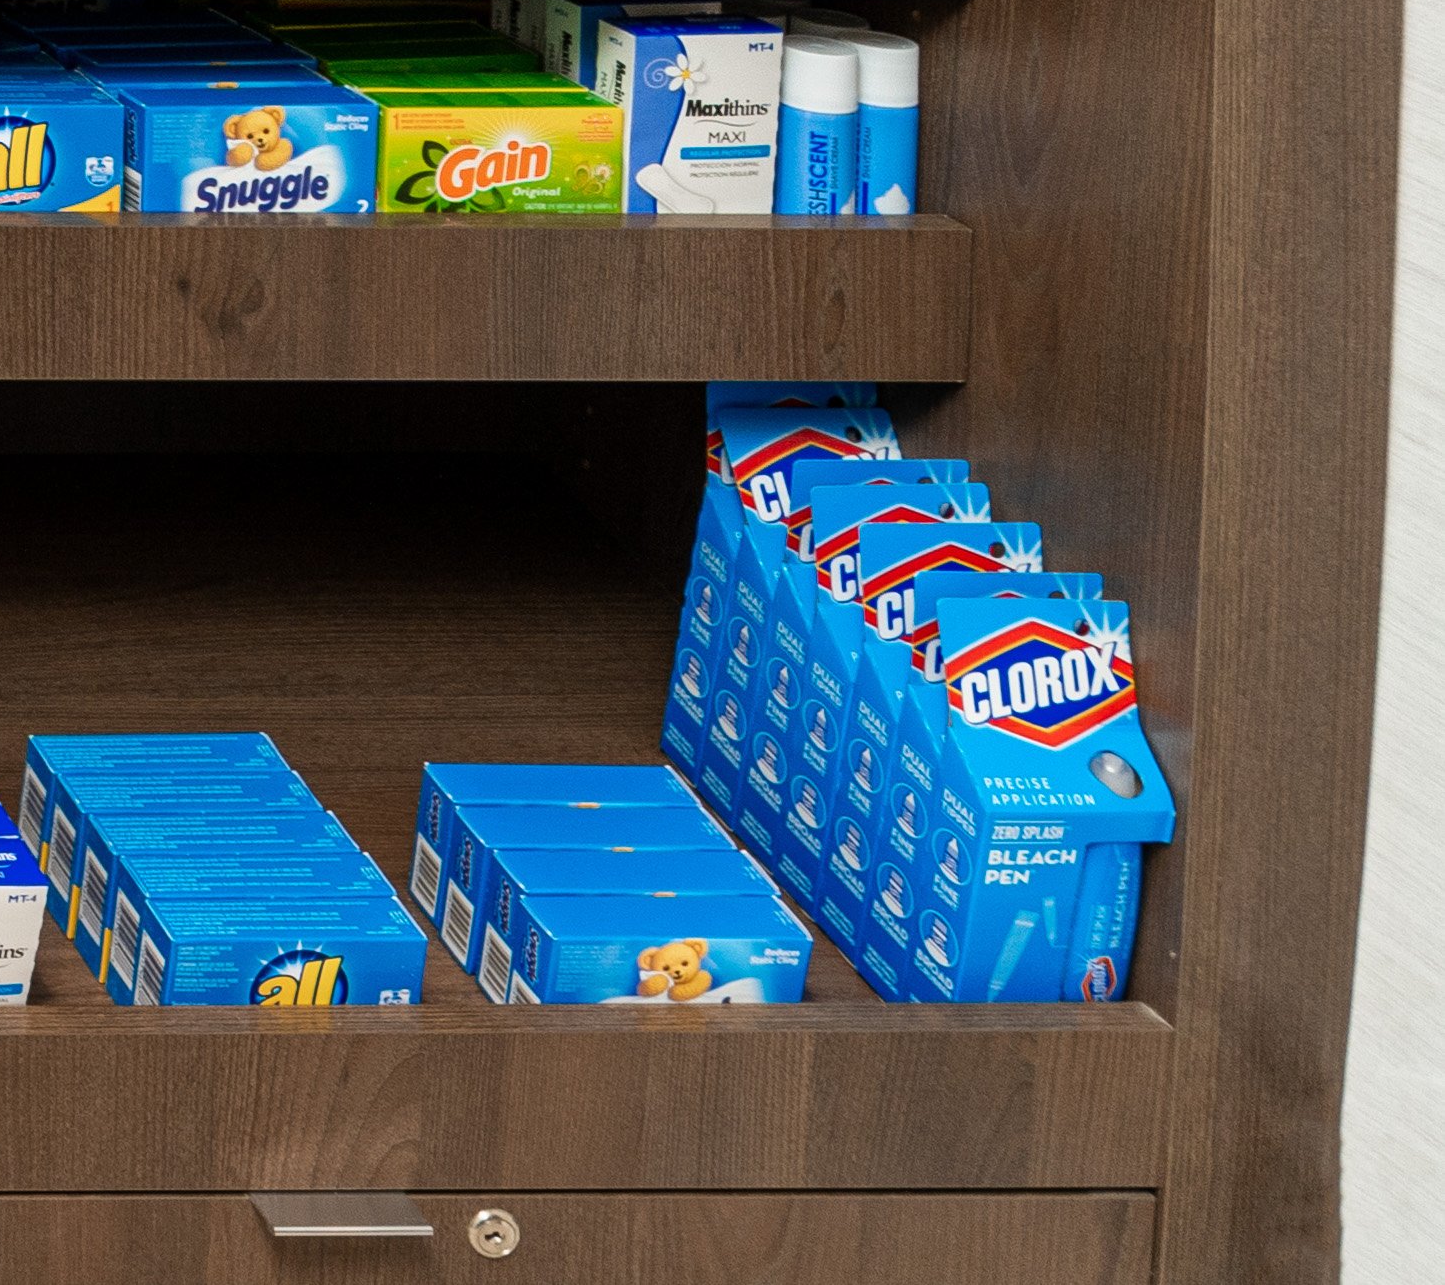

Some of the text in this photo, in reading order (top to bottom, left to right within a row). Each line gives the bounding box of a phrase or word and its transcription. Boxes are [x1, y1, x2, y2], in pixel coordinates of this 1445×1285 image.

[749, 41, 774, 52] MT-4
[708, 132, 746, 144] MAXI
[960, 643, 1117, 725] CLOROX
[984, 777, 1052, 792] PRECISE
[991, 793, 1096, 807] APPLICATION
[991, 824, 1065, 841] ZERO SPLASH
[987, 849, 1078, 868] BLEACH
